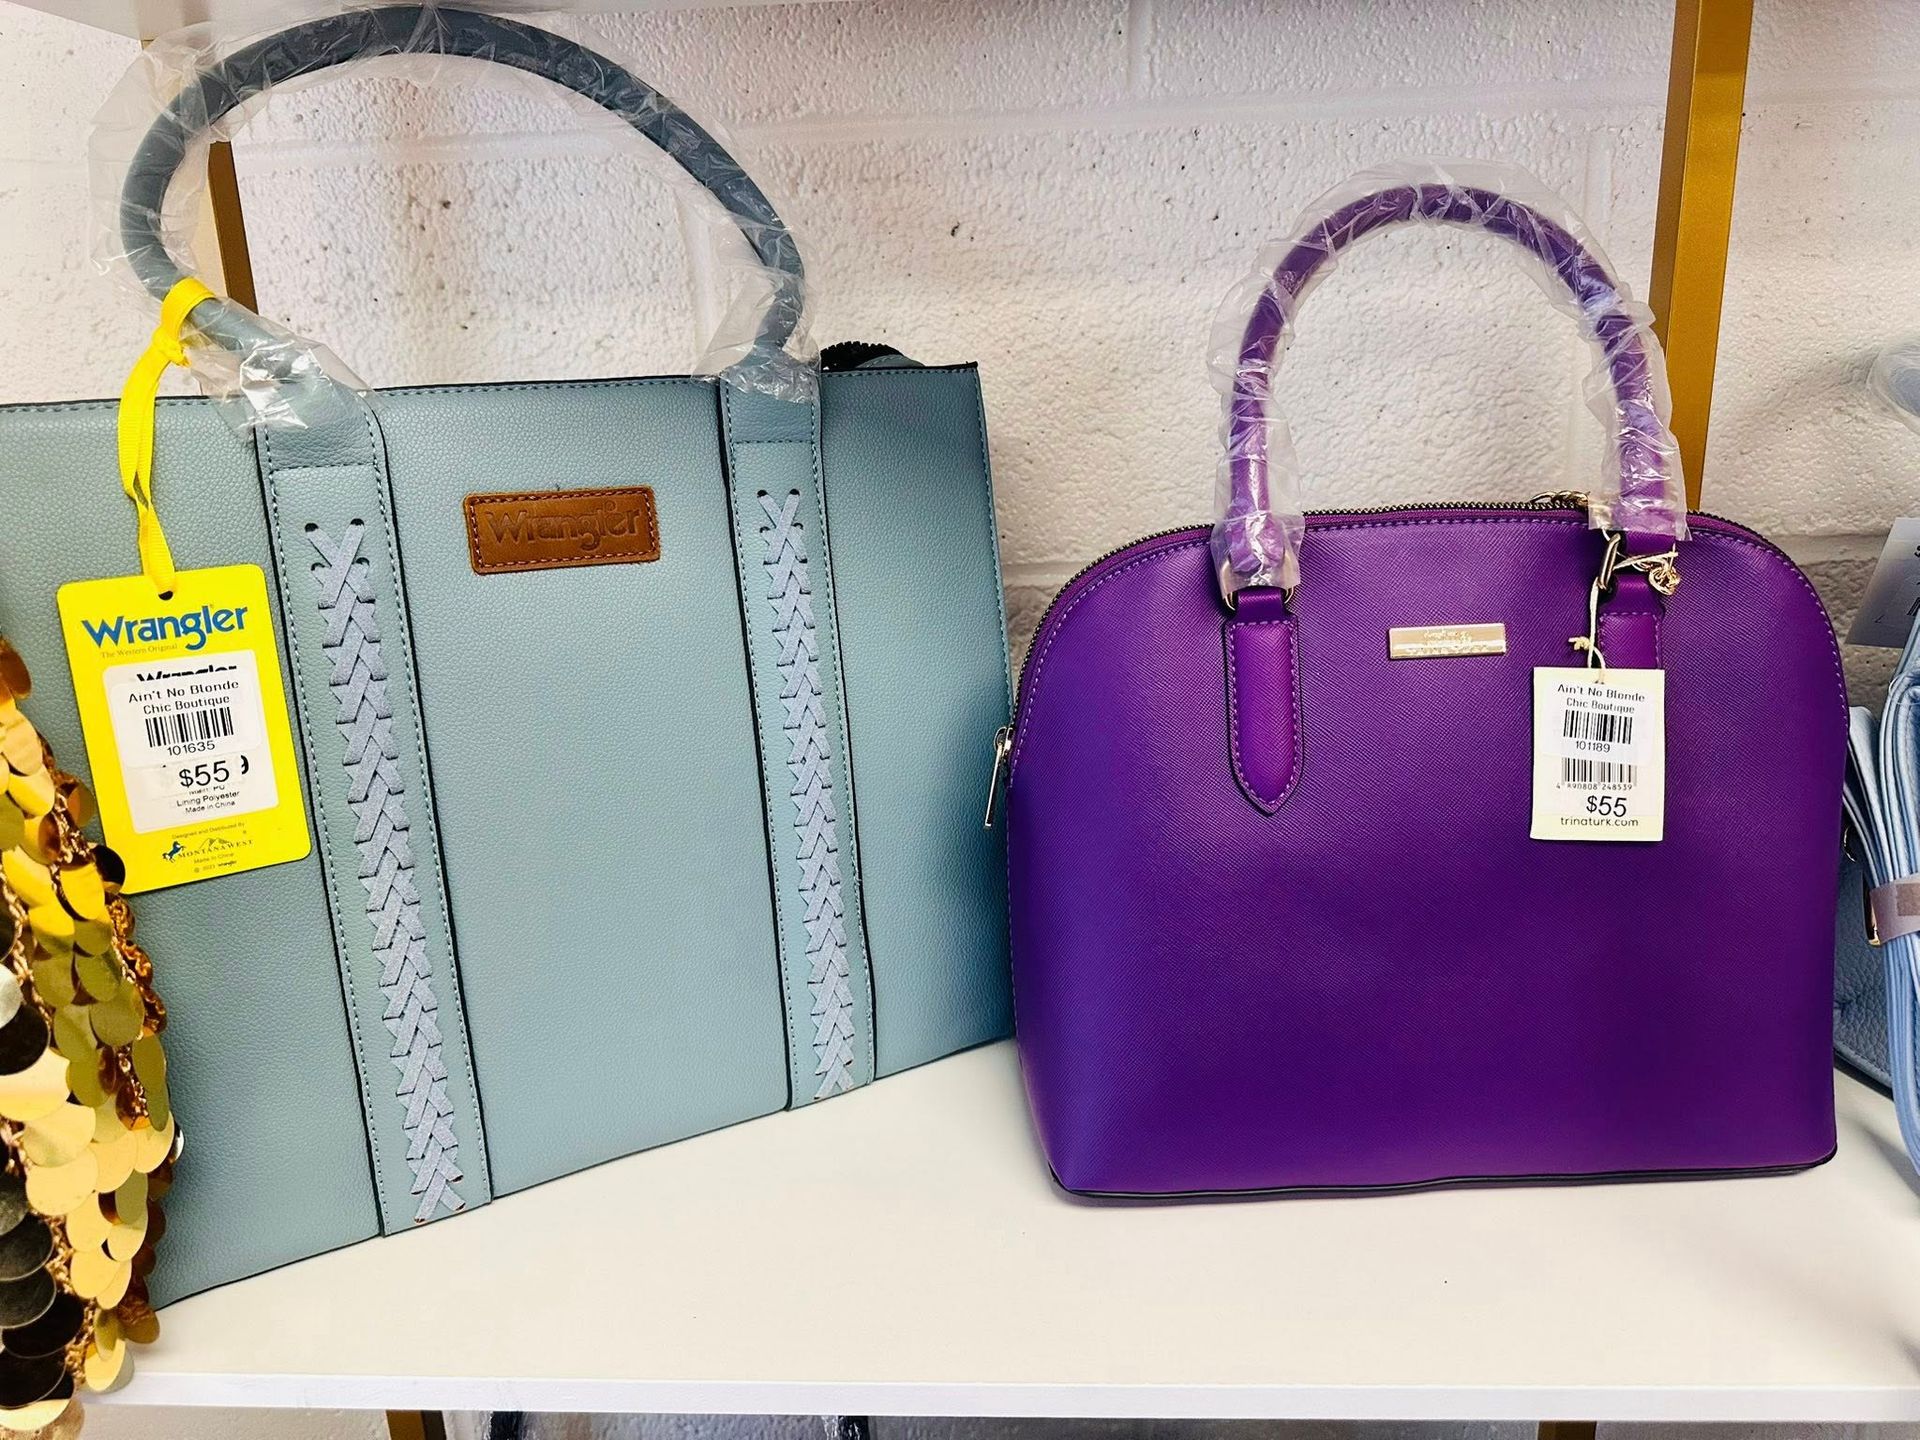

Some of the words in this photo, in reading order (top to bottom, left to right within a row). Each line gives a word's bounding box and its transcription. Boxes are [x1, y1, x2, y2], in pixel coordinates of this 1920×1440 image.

[486, 506, 641, 551] Wrangler
[81, 605, 248, 650] Wrangler
[101, 651, 115, 659] The
[117, 647, 147, 656] Western
[147, 643, 178, 653] Original
[128, 690, 162, 703] Ain't
[166, 687, 185, 698] No
[190, 681, 239, 695] Blonde
[1557, 684, 1583, 695] Ain't
[1588, 687, 1603, 697] No
[1606, 689, 1645, 702] Blonde
[143, 702, 172, 715] Chic
[175, 695, 230, 711] Boutique
[1566, 697, 1588, 708] Chic
[1591, 700, 1635, 714] Boutique
[167, 740, 215, 756] 101635
[1576, 740, 1611, 753] 101189
[178, 760, 230, 788] $55
[176, 798, 201, 807] Lining
[202, 791, 240, 802] Polyester
[215, 800, 236, 808] China
[1586, 795, 1627, 817] $55
[1560, 817, 1639, 827] trinaturk.com
